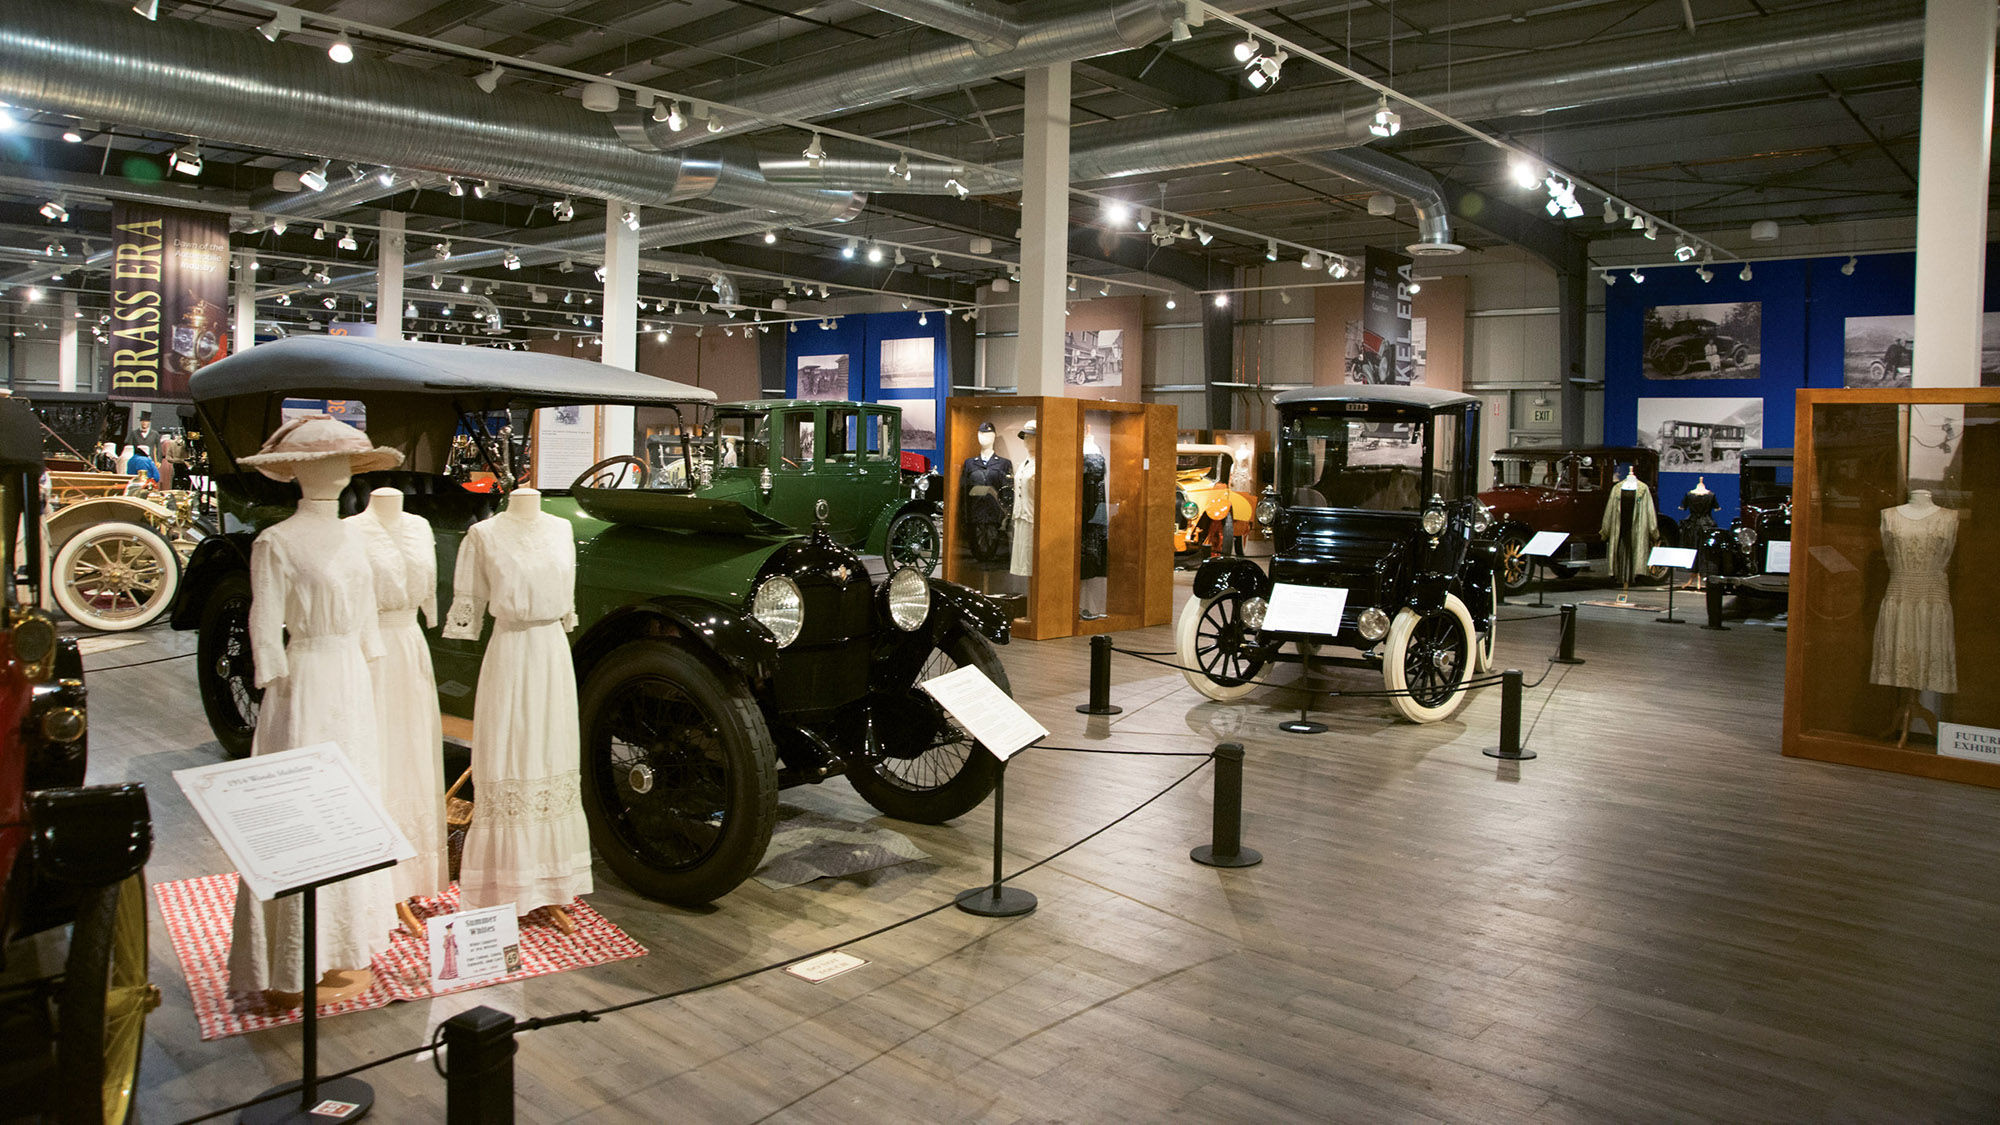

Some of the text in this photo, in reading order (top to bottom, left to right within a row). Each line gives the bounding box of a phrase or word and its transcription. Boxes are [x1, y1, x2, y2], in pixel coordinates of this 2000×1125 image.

[174, 239, 224, 251] Dawn of the
[1397, 264, 1412, 320] ERA
[113, 218, 162, 391] BRASS ERA
[1535, 410, 1550, 421] EXIT
[1954, 741, 2000, 754] EXHIBI
[465, 915, 497, 926] Summer
[470, 926, 495, 935] Whites
[507, 953, 517, 964] 69
